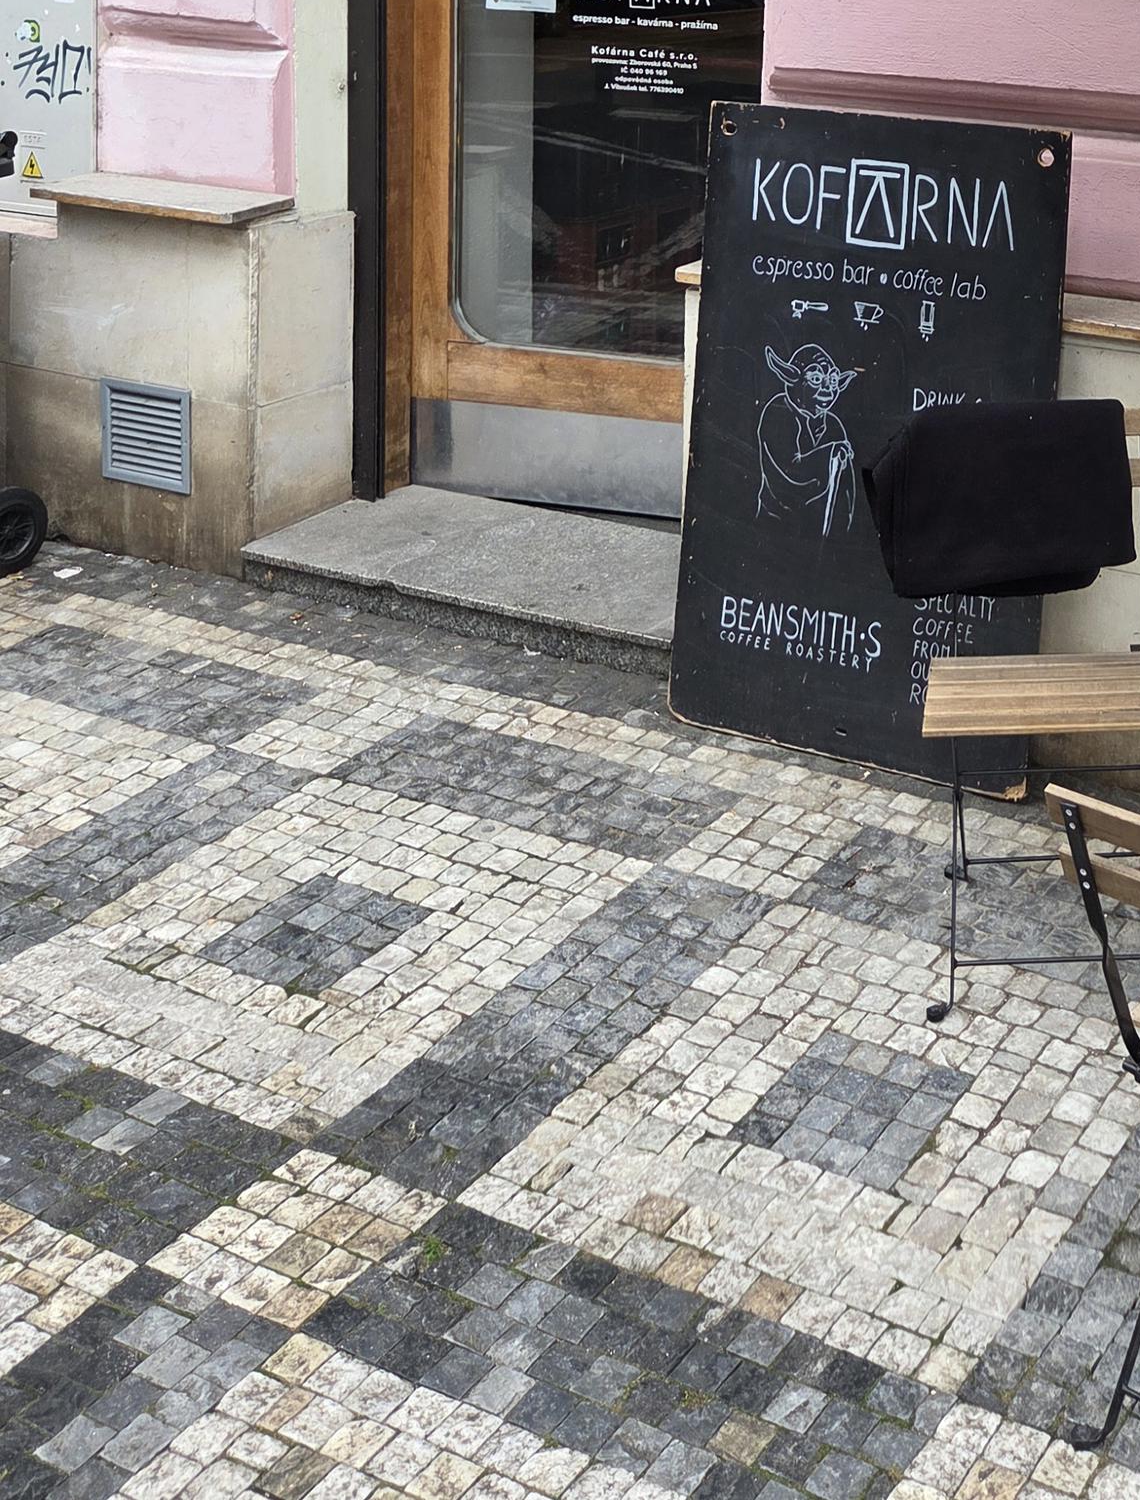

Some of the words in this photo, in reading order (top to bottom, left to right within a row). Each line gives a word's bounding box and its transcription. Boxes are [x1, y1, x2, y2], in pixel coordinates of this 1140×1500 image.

[572, 14, 613, 25] espresso
[614, 15, 630, 25] bar
[637, 16, 674, 28] kavárna
[680, 19, 719, 31] pražírna
[591, 45, 635, 57] Kofárna
[639, 48, 666, 59] Café
[669, 51, 698, 61] s.r.o.
[752, 253, 834, 284] espresso
[842, 258, 873, 285] bar
[893, 267, 944, 297] coffee
[950, 271, 987, 301] lab
[720, 629, 771, 650] COFFEE
[785, 641, 873, 674] ROASTERY
[912, 639, 951, 659] FROM
